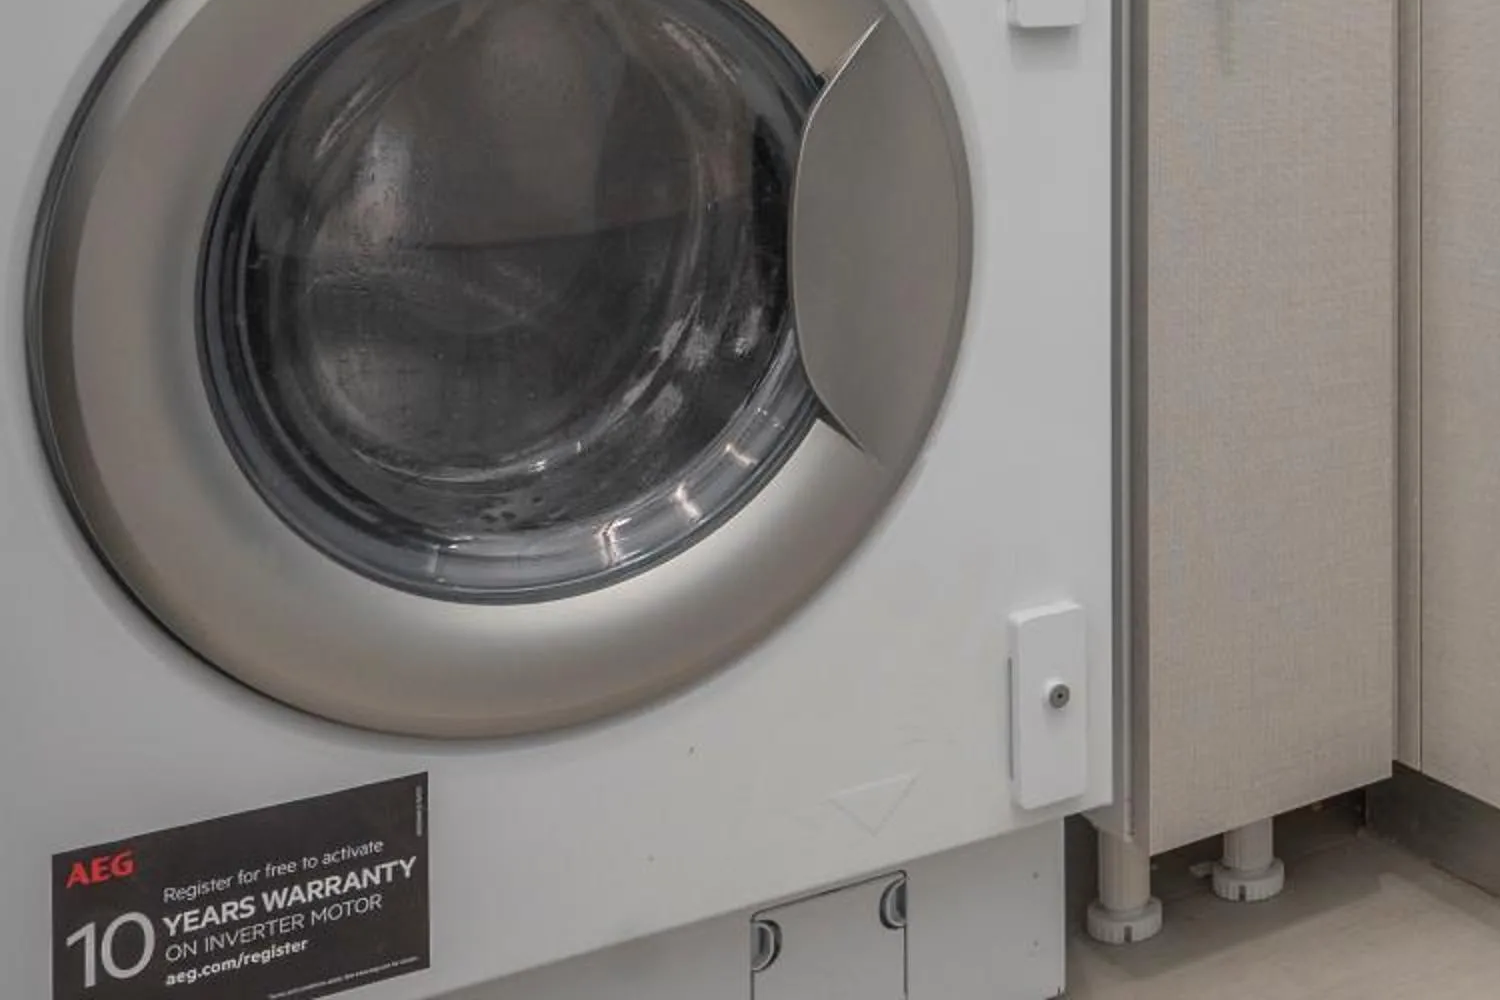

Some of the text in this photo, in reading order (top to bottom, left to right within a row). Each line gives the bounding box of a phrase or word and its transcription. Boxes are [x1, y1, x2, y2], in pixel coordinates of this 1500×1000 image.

[66, 849, 135, 888] AEG
[163, 840, 385, 904] Register for free to activate
[66, 855, 418, 989] 10 YEARS WARRANTY
[165, 894, 383, 962] ON INVERTER MOTOR
[165, 937, 309, 988] aeg.com/register
